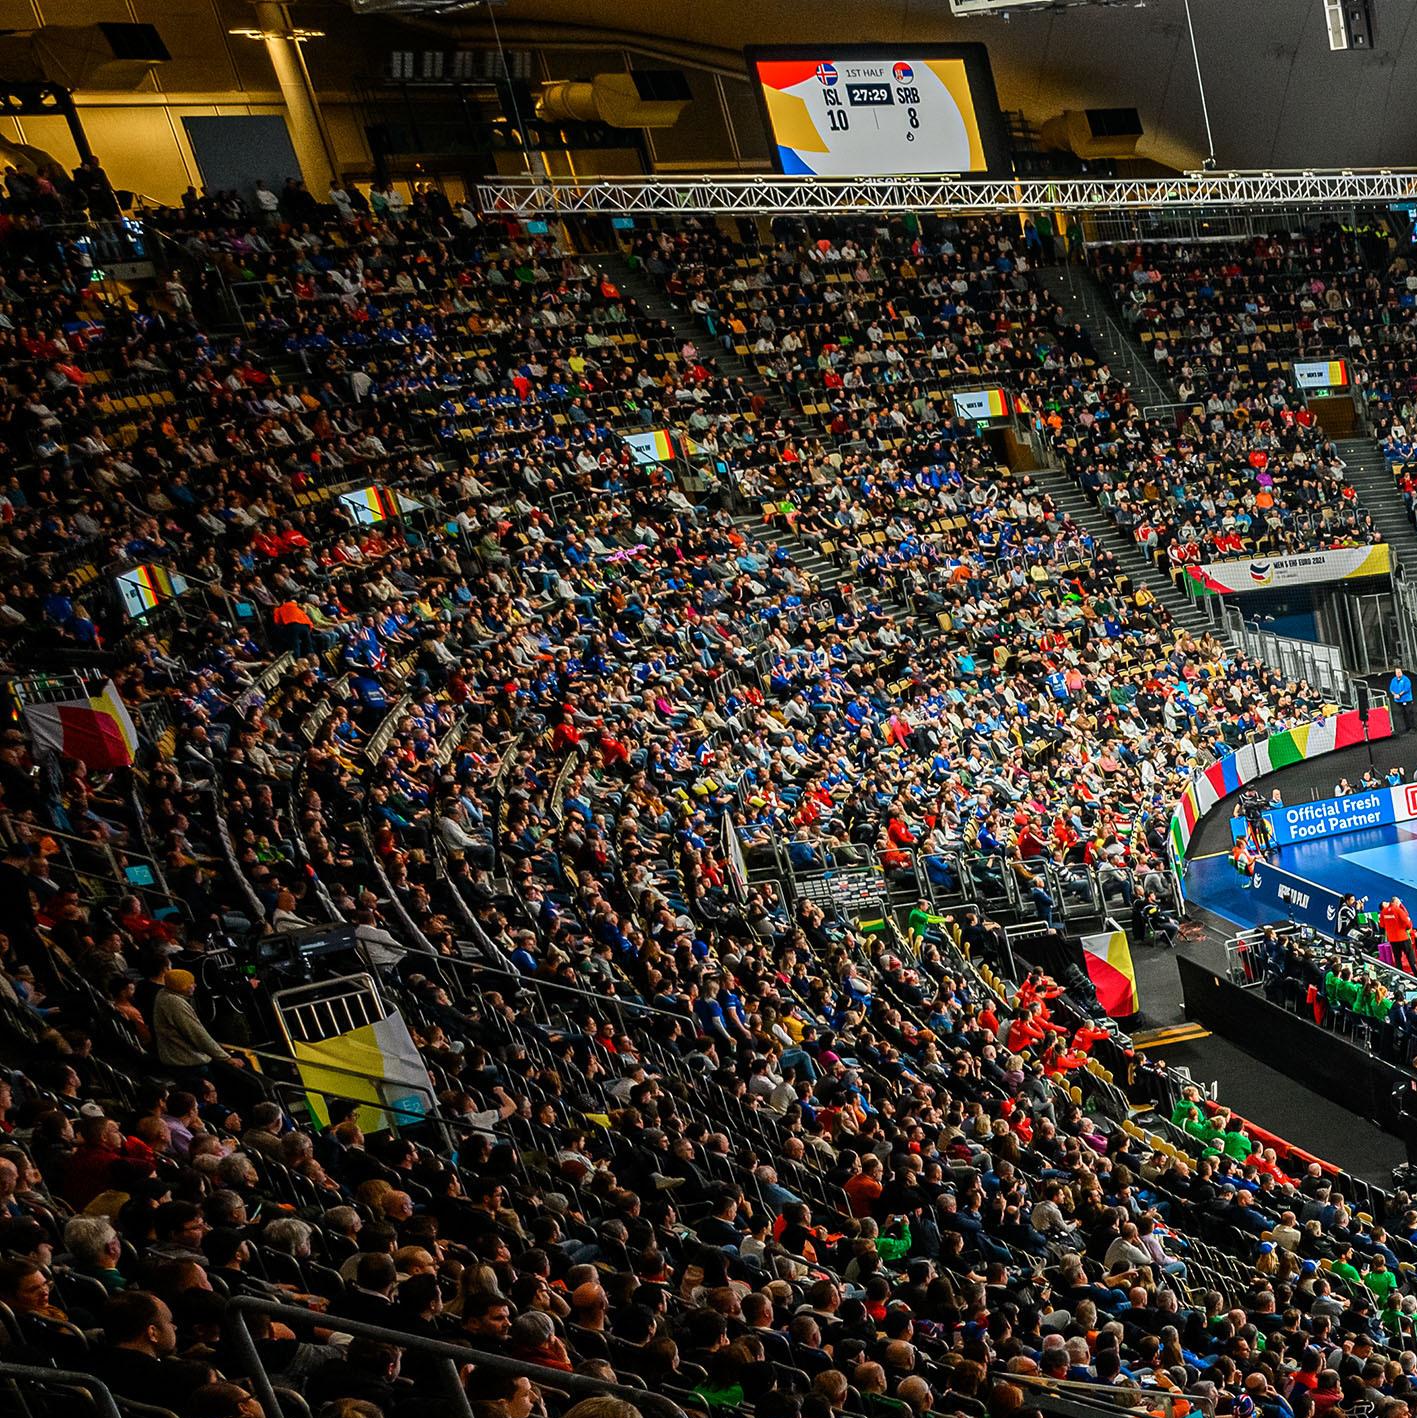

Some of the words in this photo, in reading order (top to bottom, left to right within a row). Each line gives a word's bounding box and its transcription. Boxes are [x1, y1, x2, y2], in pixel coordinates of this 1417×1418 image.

[846, 69, 861, 78] 1ST
[863, 69, 884, 77] HALF
[823, 88, 842, 106] ISL
[852, 89, 888, 101] 27:29
[896, 87, 920, 104] SRB
[827, 109, 849, 131] 10
[907, 107, 919, 129] 8
[1286, 801, 1340, 824] Official
[1342, 793, 1380, 813] Fresh
[1290, 818, 1326, 840] Food
[1329, 810, 1381, 833] Partner
